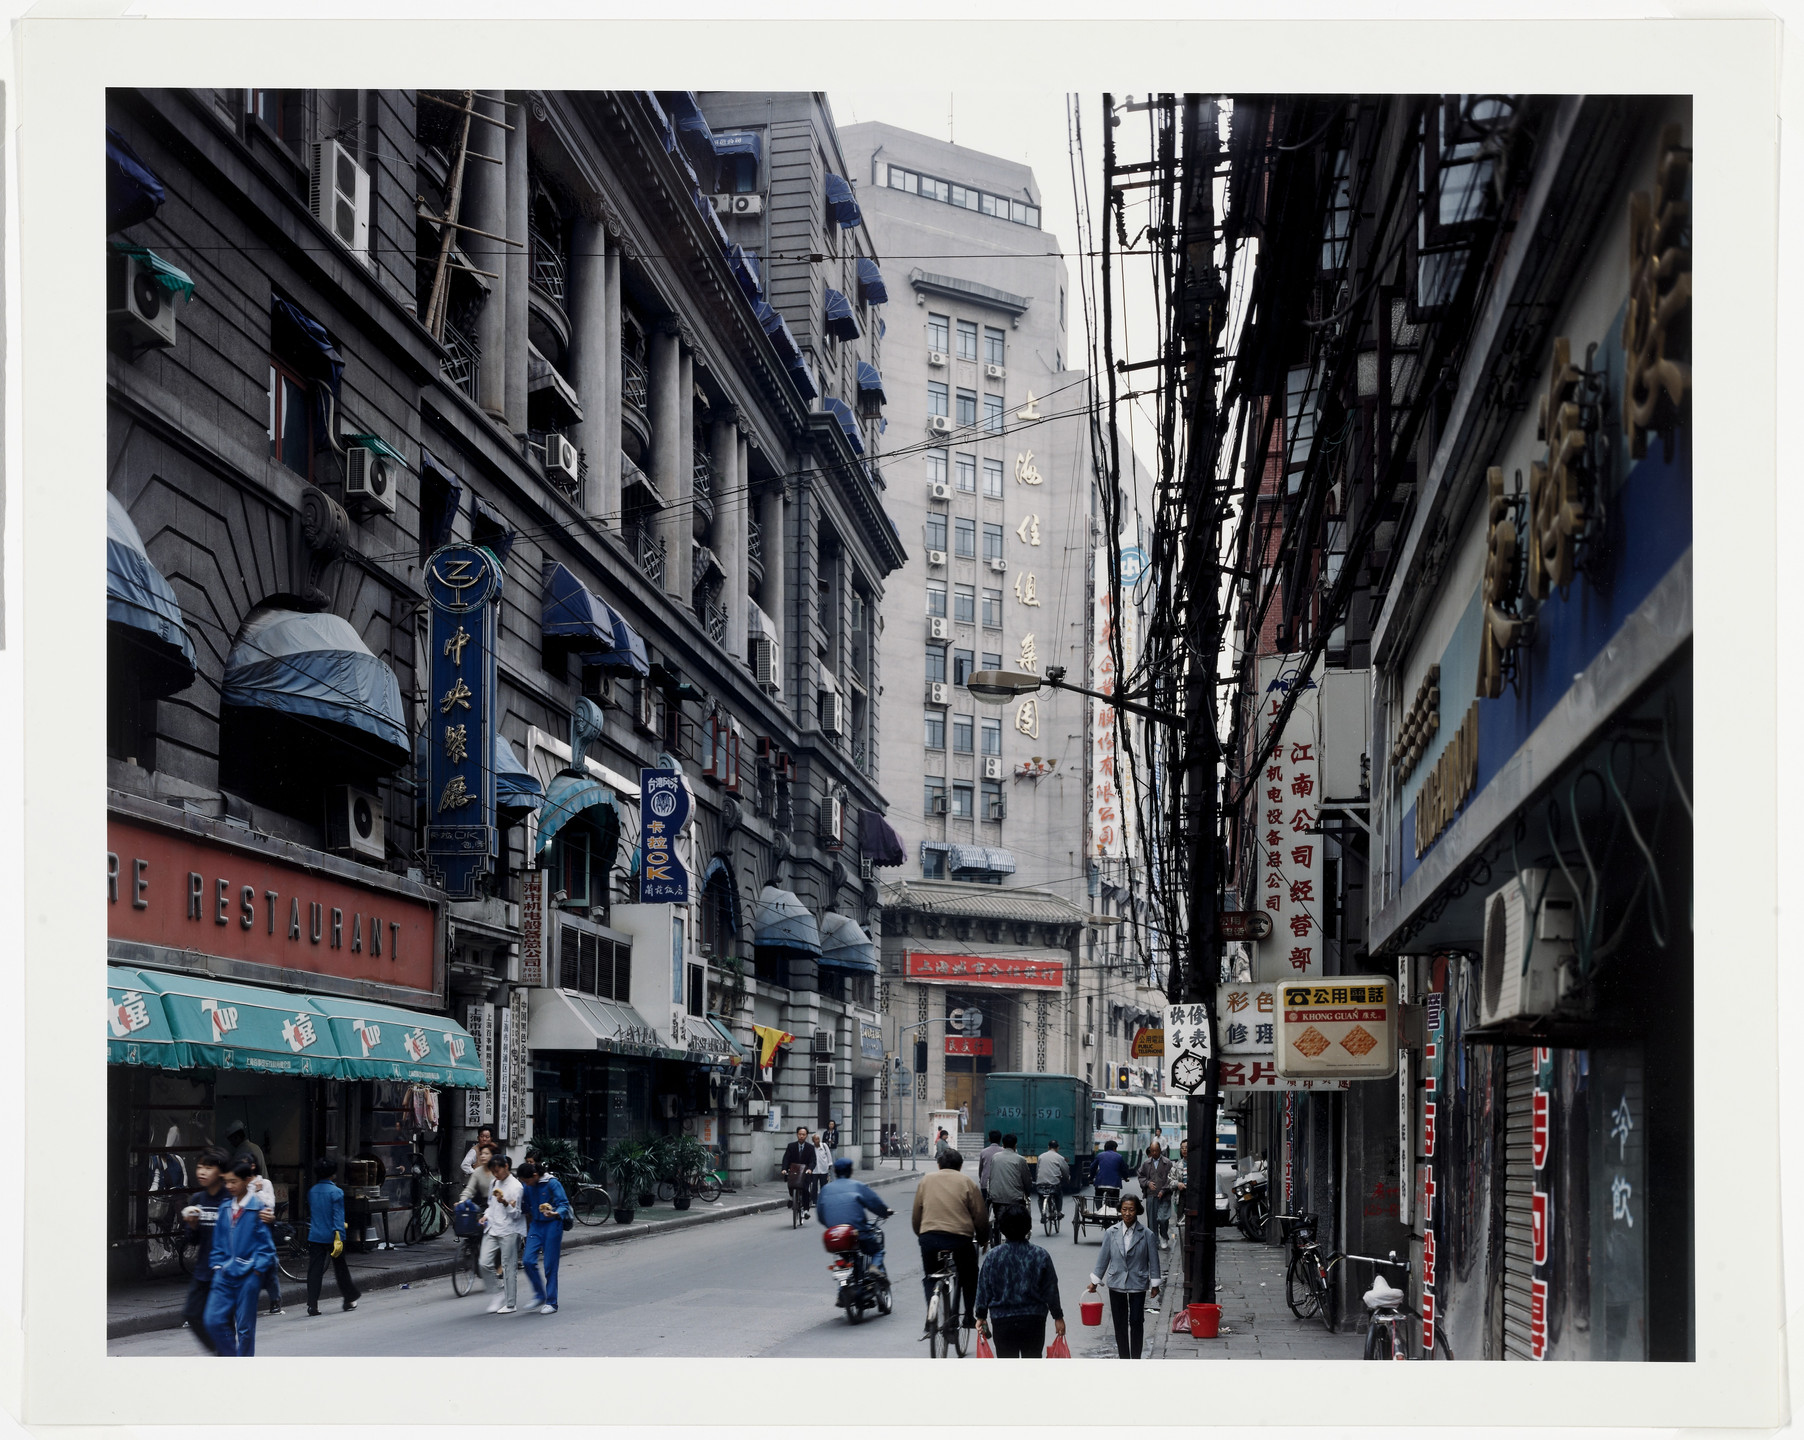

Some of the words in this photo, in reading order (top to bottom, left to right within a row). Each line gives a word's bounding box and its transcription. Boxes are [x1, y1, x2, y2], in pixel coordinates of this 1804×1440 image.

[1266, 699, 1284, 912] 上市机电设备总公司
[1289, 742, 1315, 974] 江南公司经营部
[188, 871, 401, 960] RESTAURANT
[1226, 991, 1273, 1013] 彩色
[1313, 987, 1384, 1004] 公用電話
[201, 1000, 238, 1042] 7UP
[1170, 1005, 1208, 1025] 快修
[1302, 1013, 1333, 1021] KHONG
[1335, 1012, 1358, 1020] GUAN
[353, 1019, 381, 1057] 7UP
[1172, 1028, 1207, 1048] 手表
[1226, 1023, 1273, 1044] 修理
[443, 1033, 465, 1066] 7UP
[1220, 1061, 1278, 1085] 名片
